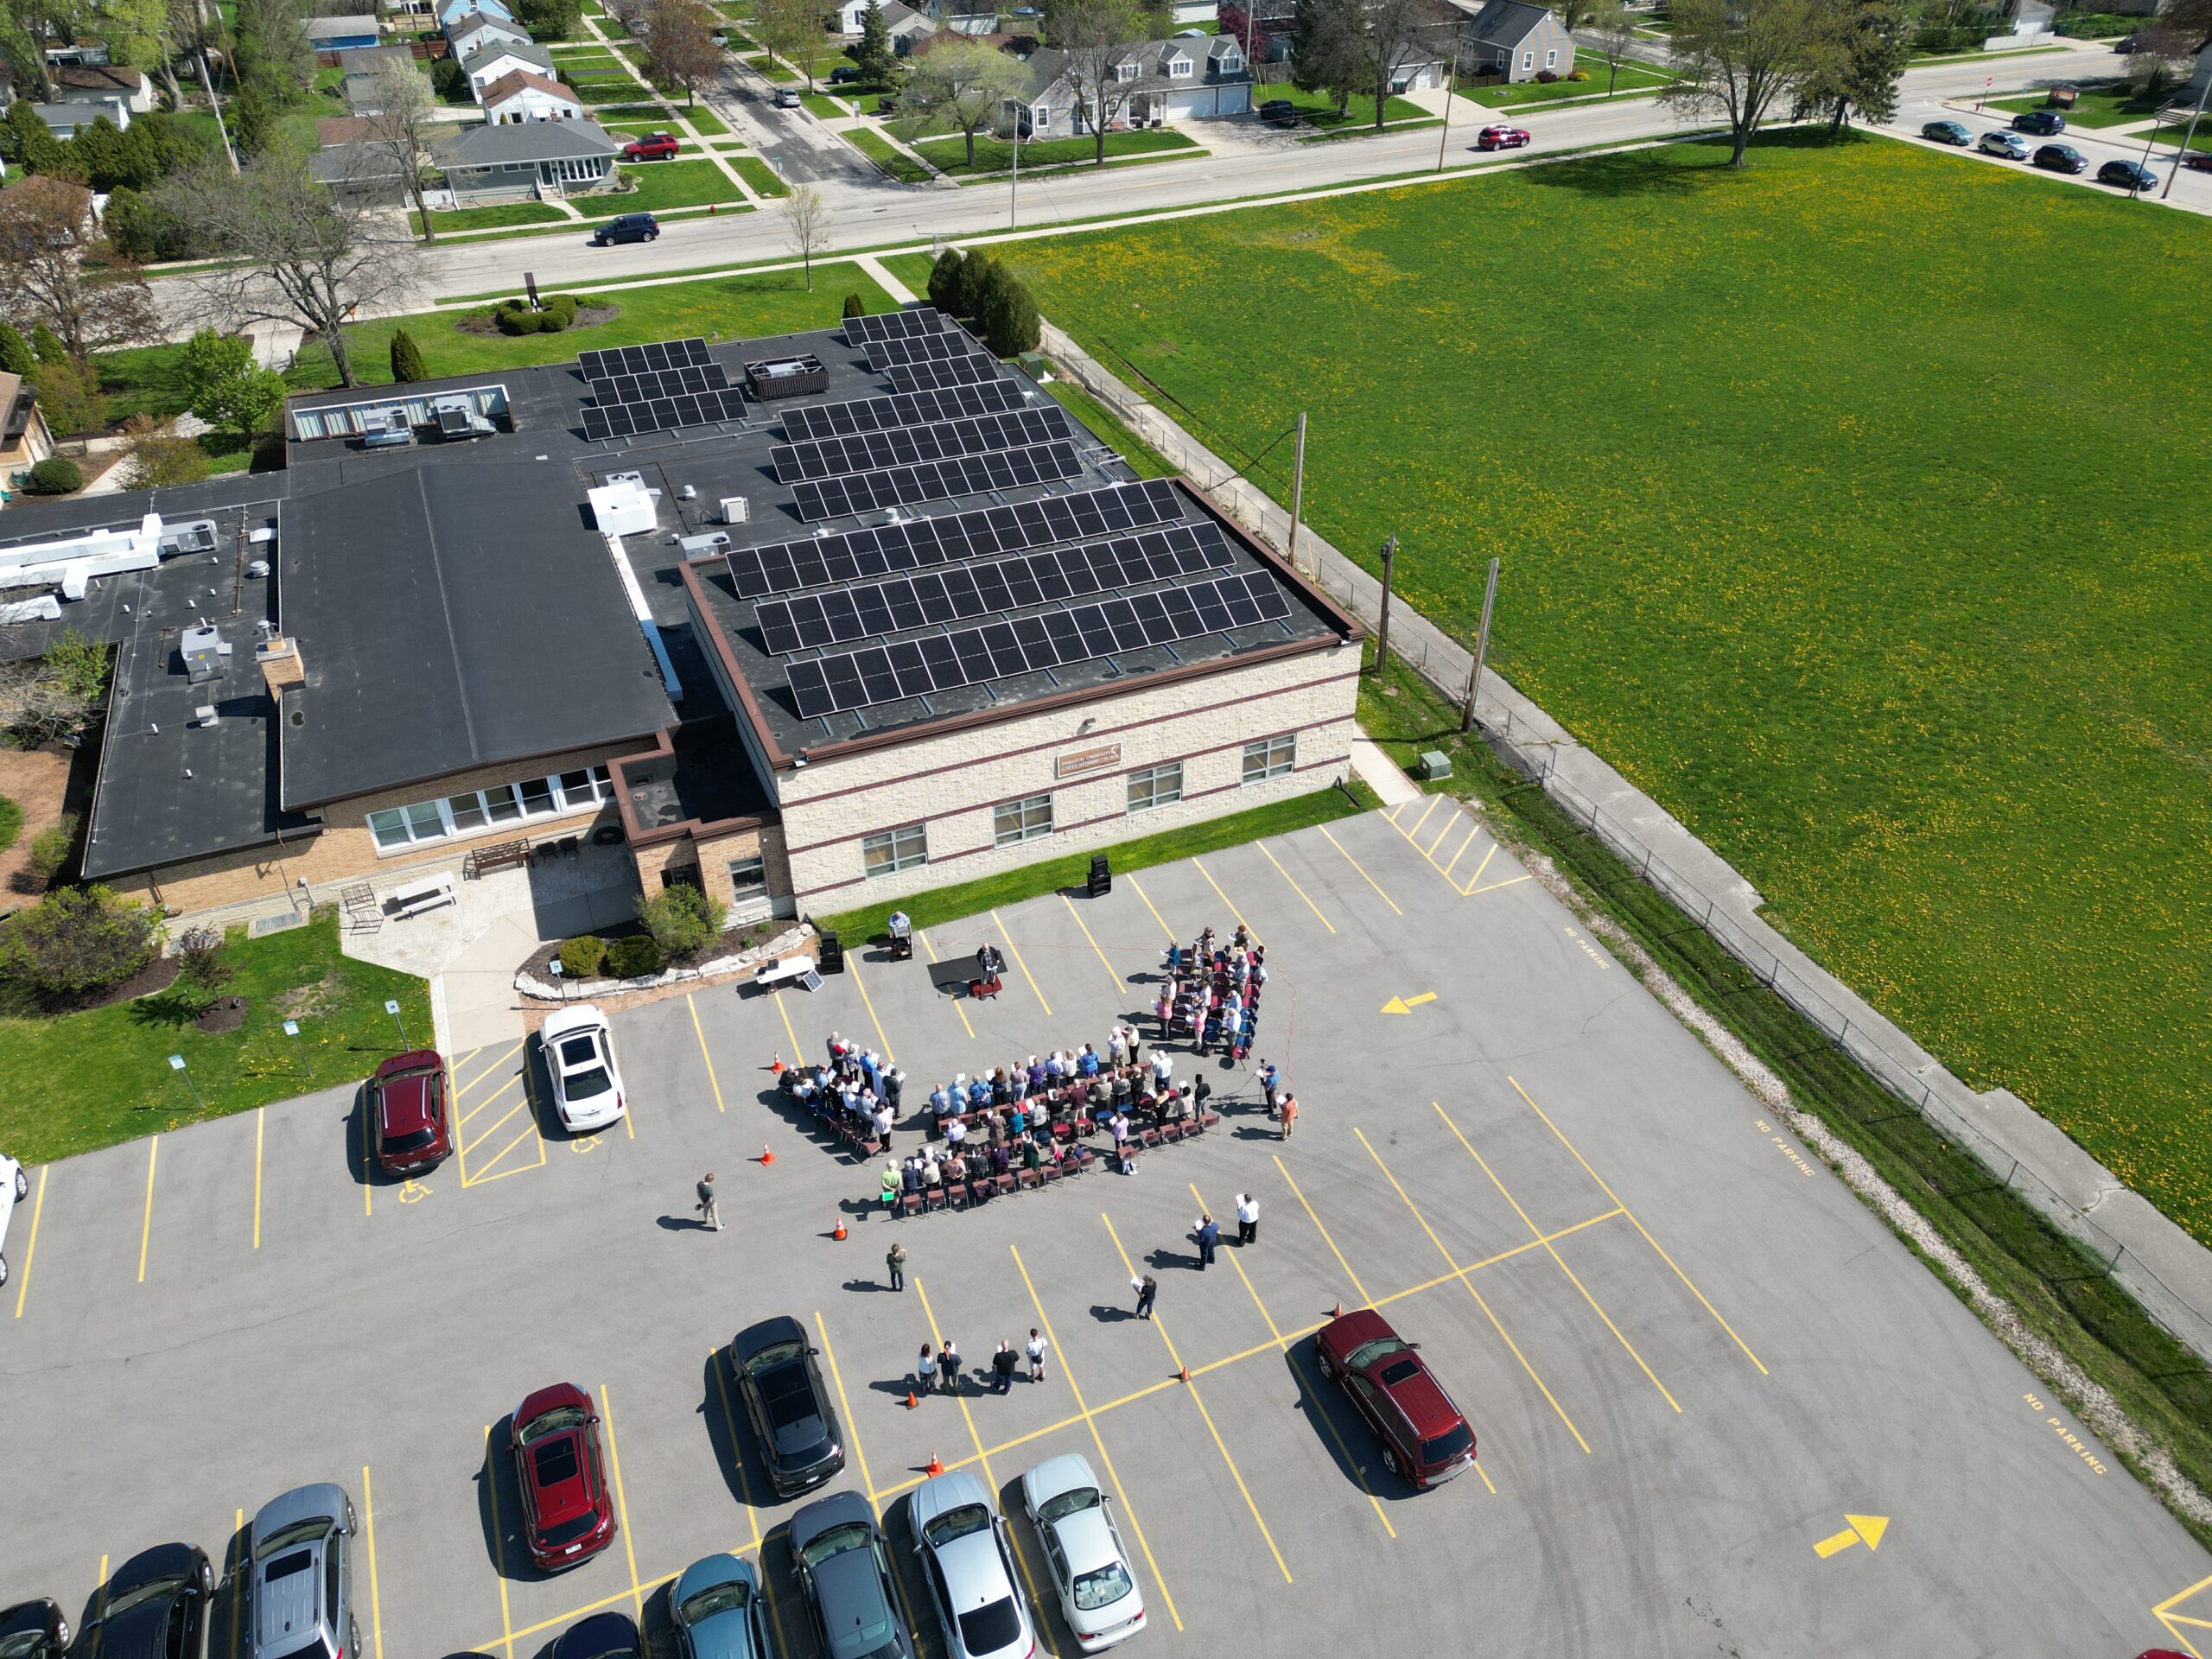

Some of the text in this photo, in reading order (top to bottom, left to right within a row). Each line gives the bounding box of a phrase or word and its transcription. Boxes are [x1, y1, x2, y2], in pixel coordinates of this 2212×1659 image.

[1078, 759, 1101, 767] METHODIST
[1564, 927, 1610, 969] NO PARKING
[1755, 1120, 1815, 1177] NO PARKING
[2023, 1393, 2107, 1475] NO PARKING
